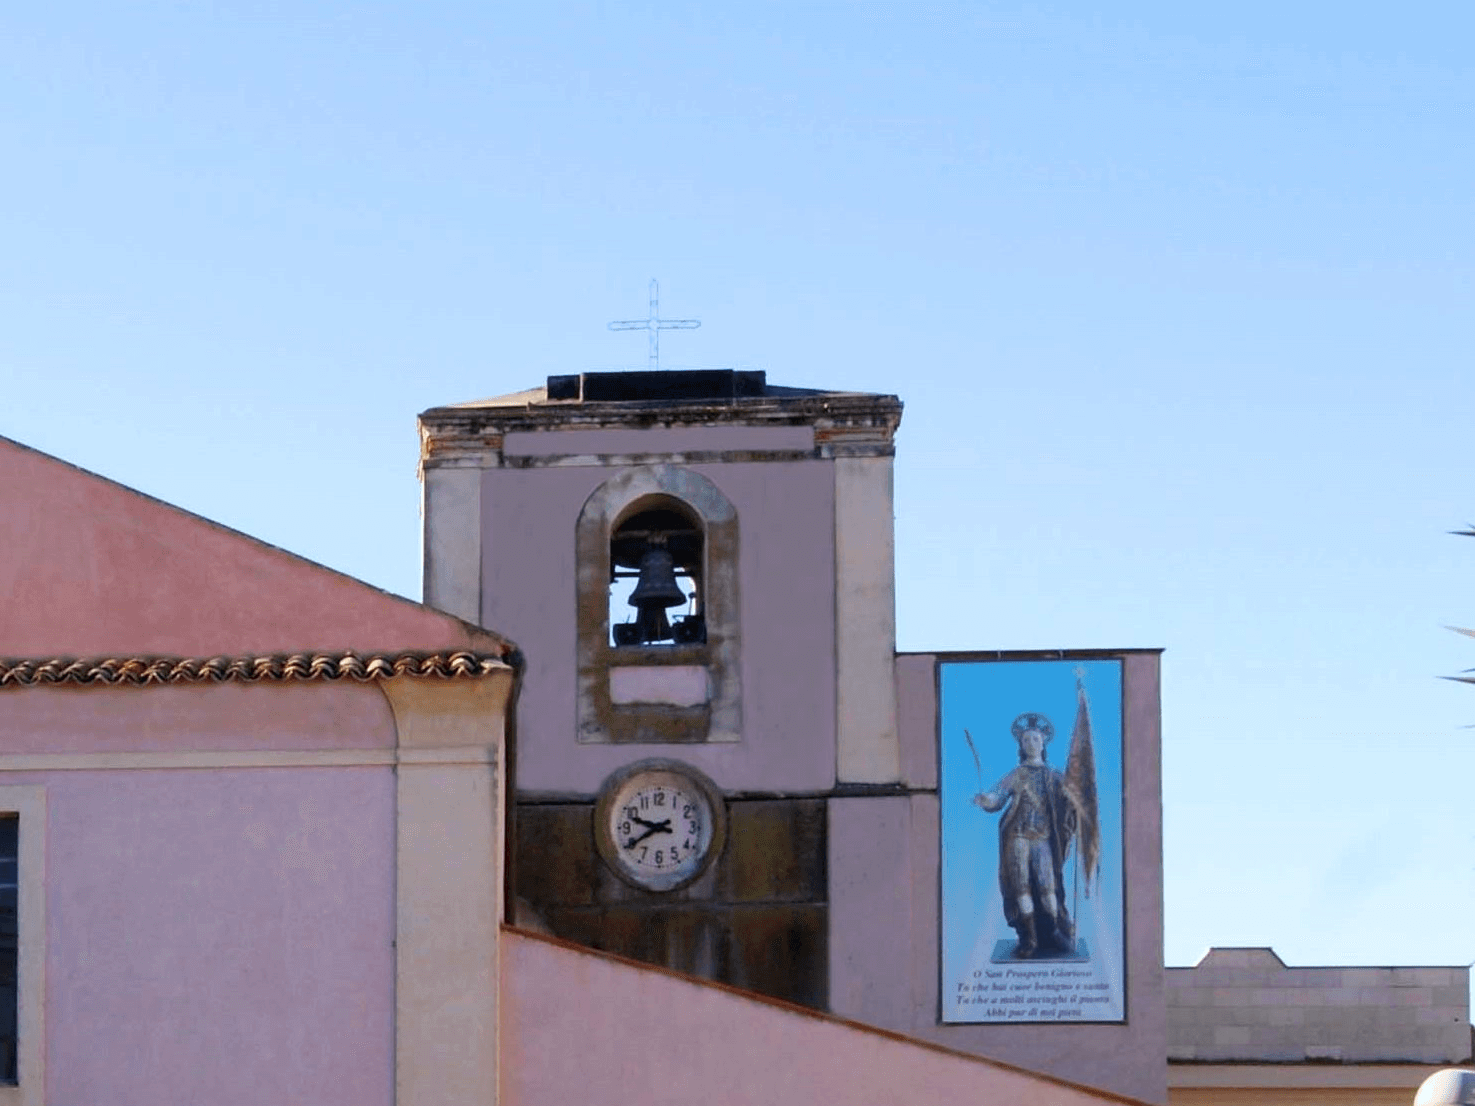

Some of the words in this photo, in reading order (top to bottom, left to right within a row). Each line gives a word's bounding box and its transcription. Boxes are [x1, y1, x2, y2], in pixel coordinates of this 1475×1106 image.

[641, 796, 649, 810] 11
[654, 792, 665, 806] 12
[672, 796, 676, 808] 1
[627, 806, 638, 818] 10
[683, 805, 691, 819] 2
[622, 822, 631, 834] 9
[689, 821, 696, 834] 3
[683, 838, 690, 849] 4
[640, 847, 648, 860] 7
[655, 851, 662, 864] 6
[670, 847, 678, 860] 5
[1006, 969, 1049, 980] Prospero
